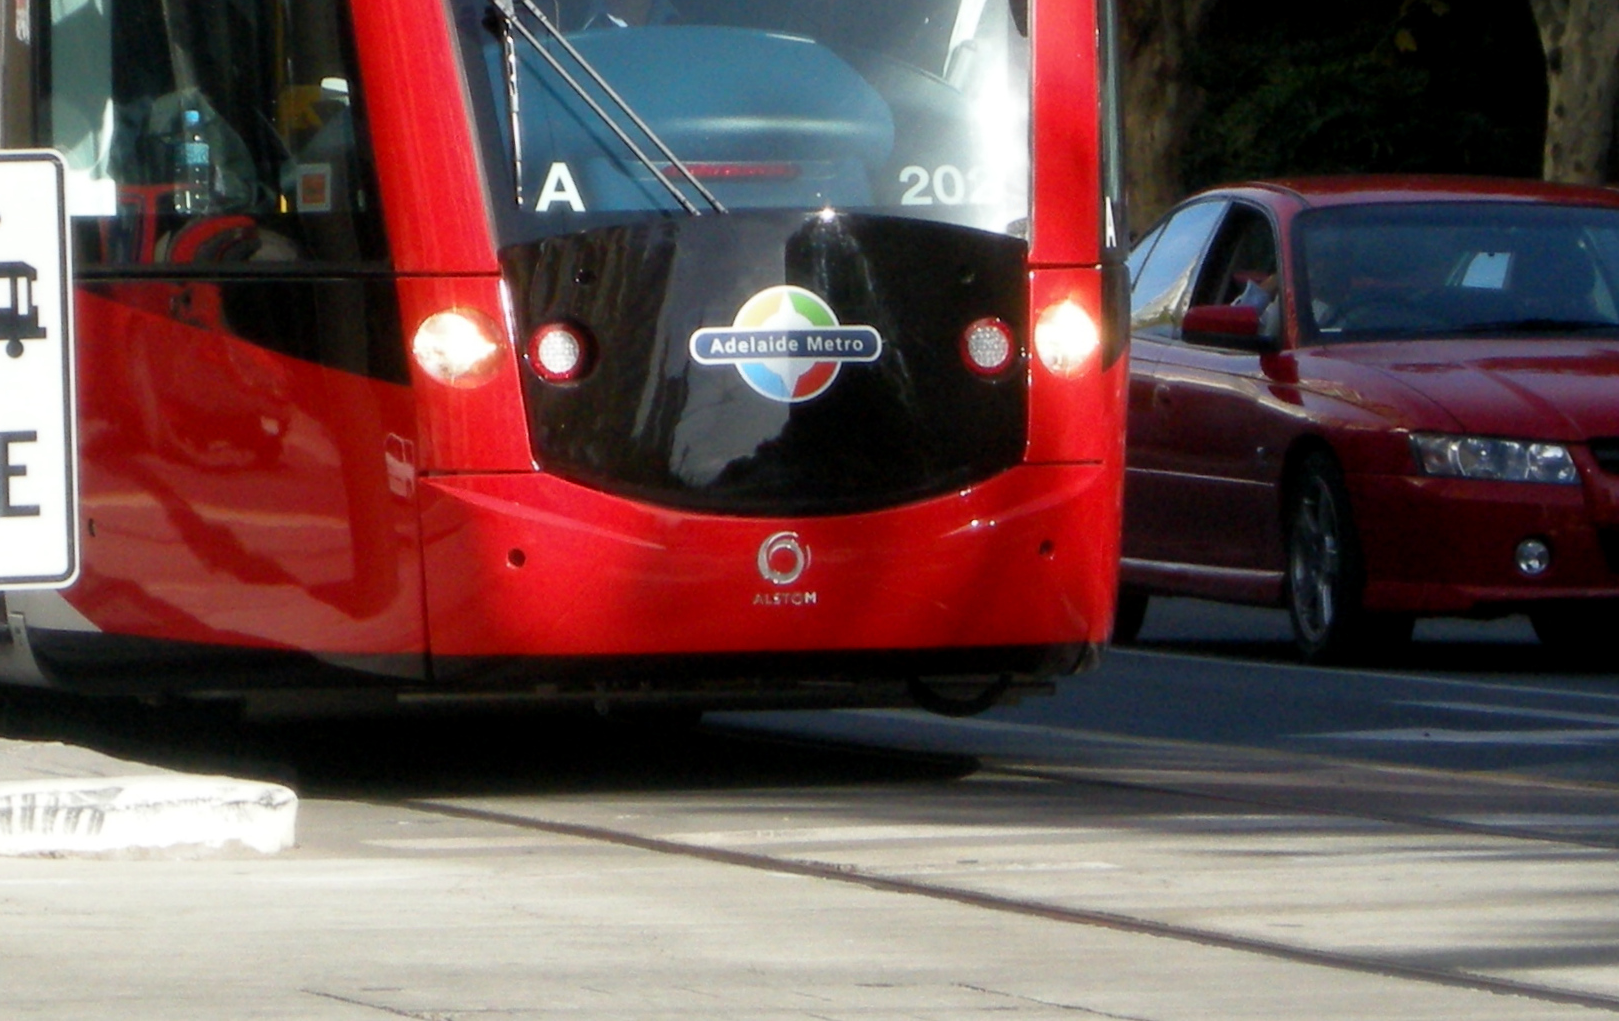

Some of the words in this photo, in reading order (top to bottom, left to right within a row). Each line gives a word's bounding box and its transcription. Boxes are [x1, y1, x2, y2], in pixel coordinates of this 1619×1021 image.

[535, 162, 586, 212] A
[710, 335, 799, 354] Adelaide
[807, 335, 864, 352] Metro
[753, 591, 817, 606] ALSTOM
